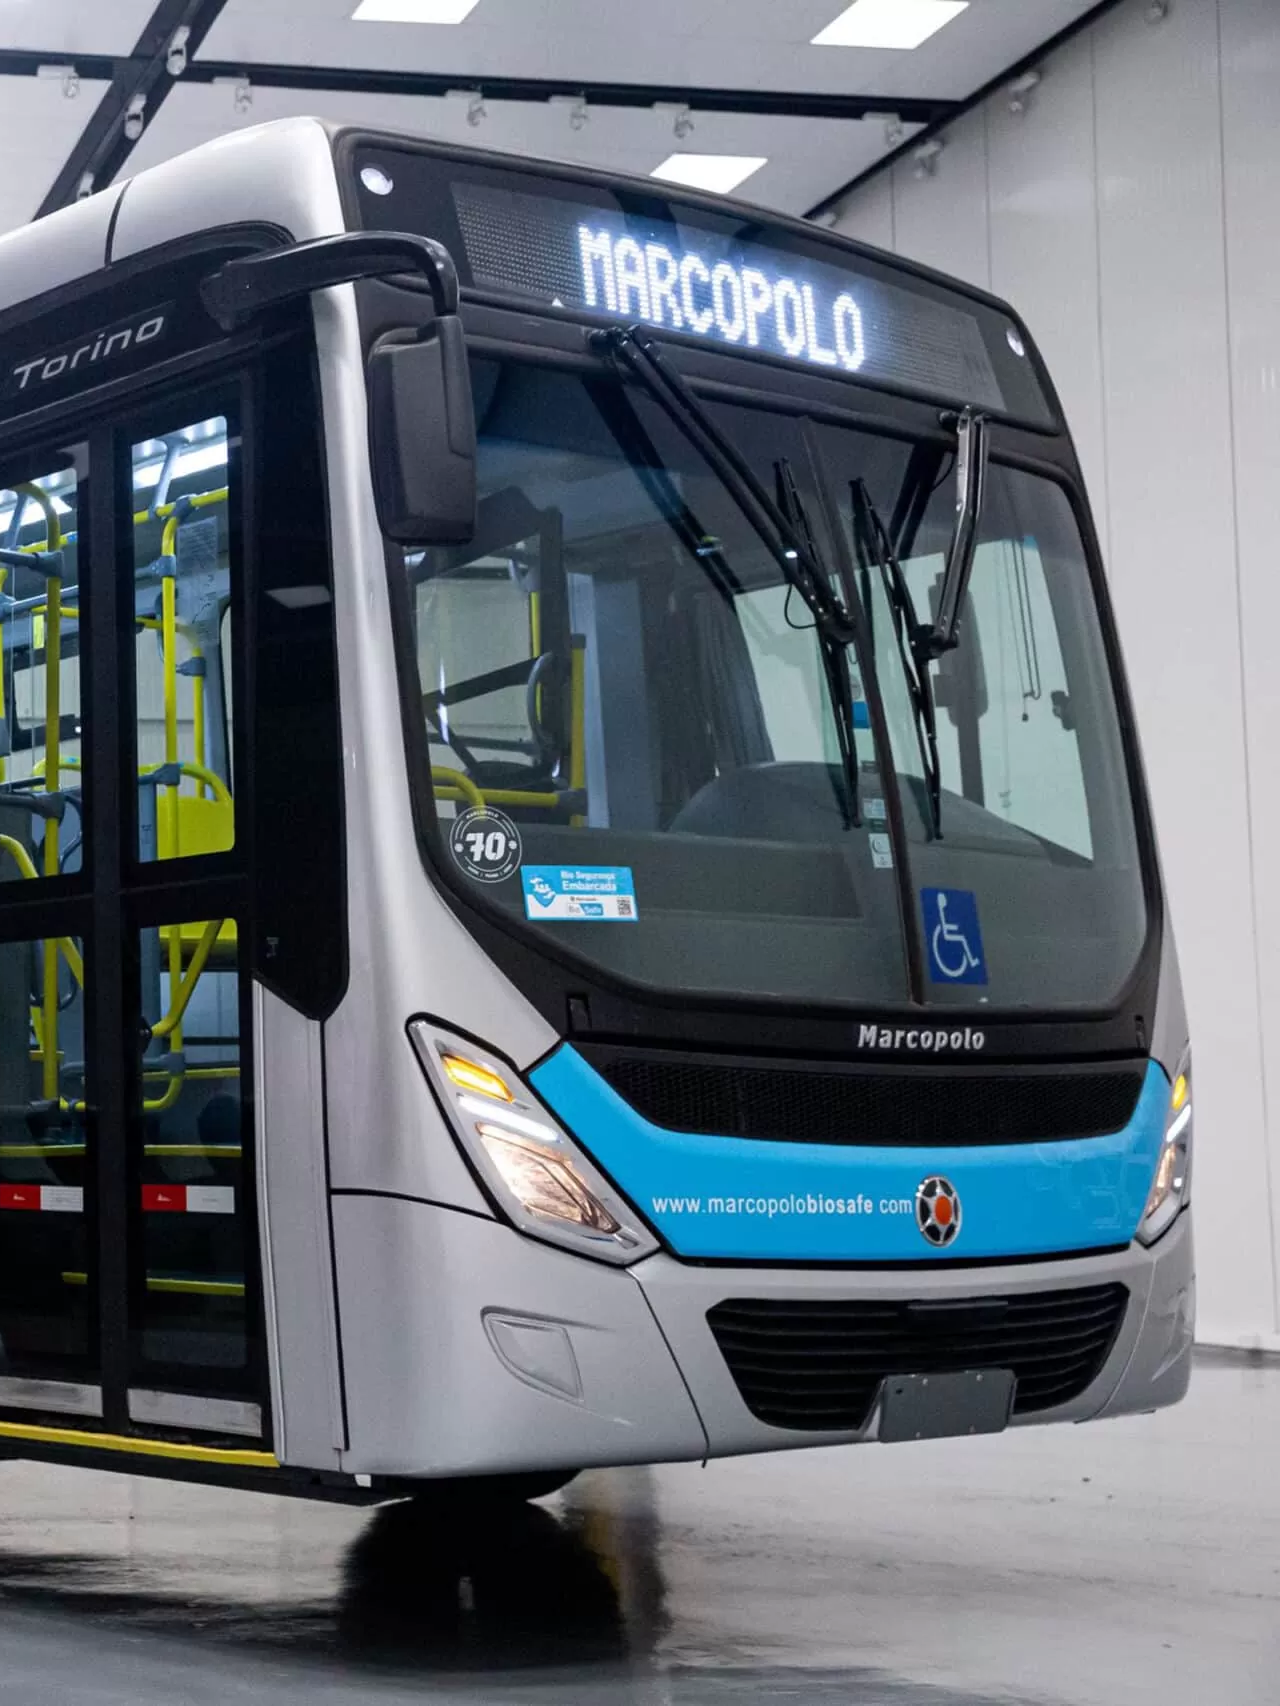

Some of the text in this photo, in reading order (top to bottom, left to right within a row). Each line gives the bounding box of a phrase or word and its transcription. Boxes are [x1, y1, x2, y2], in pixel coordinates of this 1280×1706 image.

[577, 223, 867, 372] MARCOPOLO
[13, 315, 165, 390] Torino
[465, 832, 506, 862] 70
[858, 1024, 985, 1052] Marcopolo
